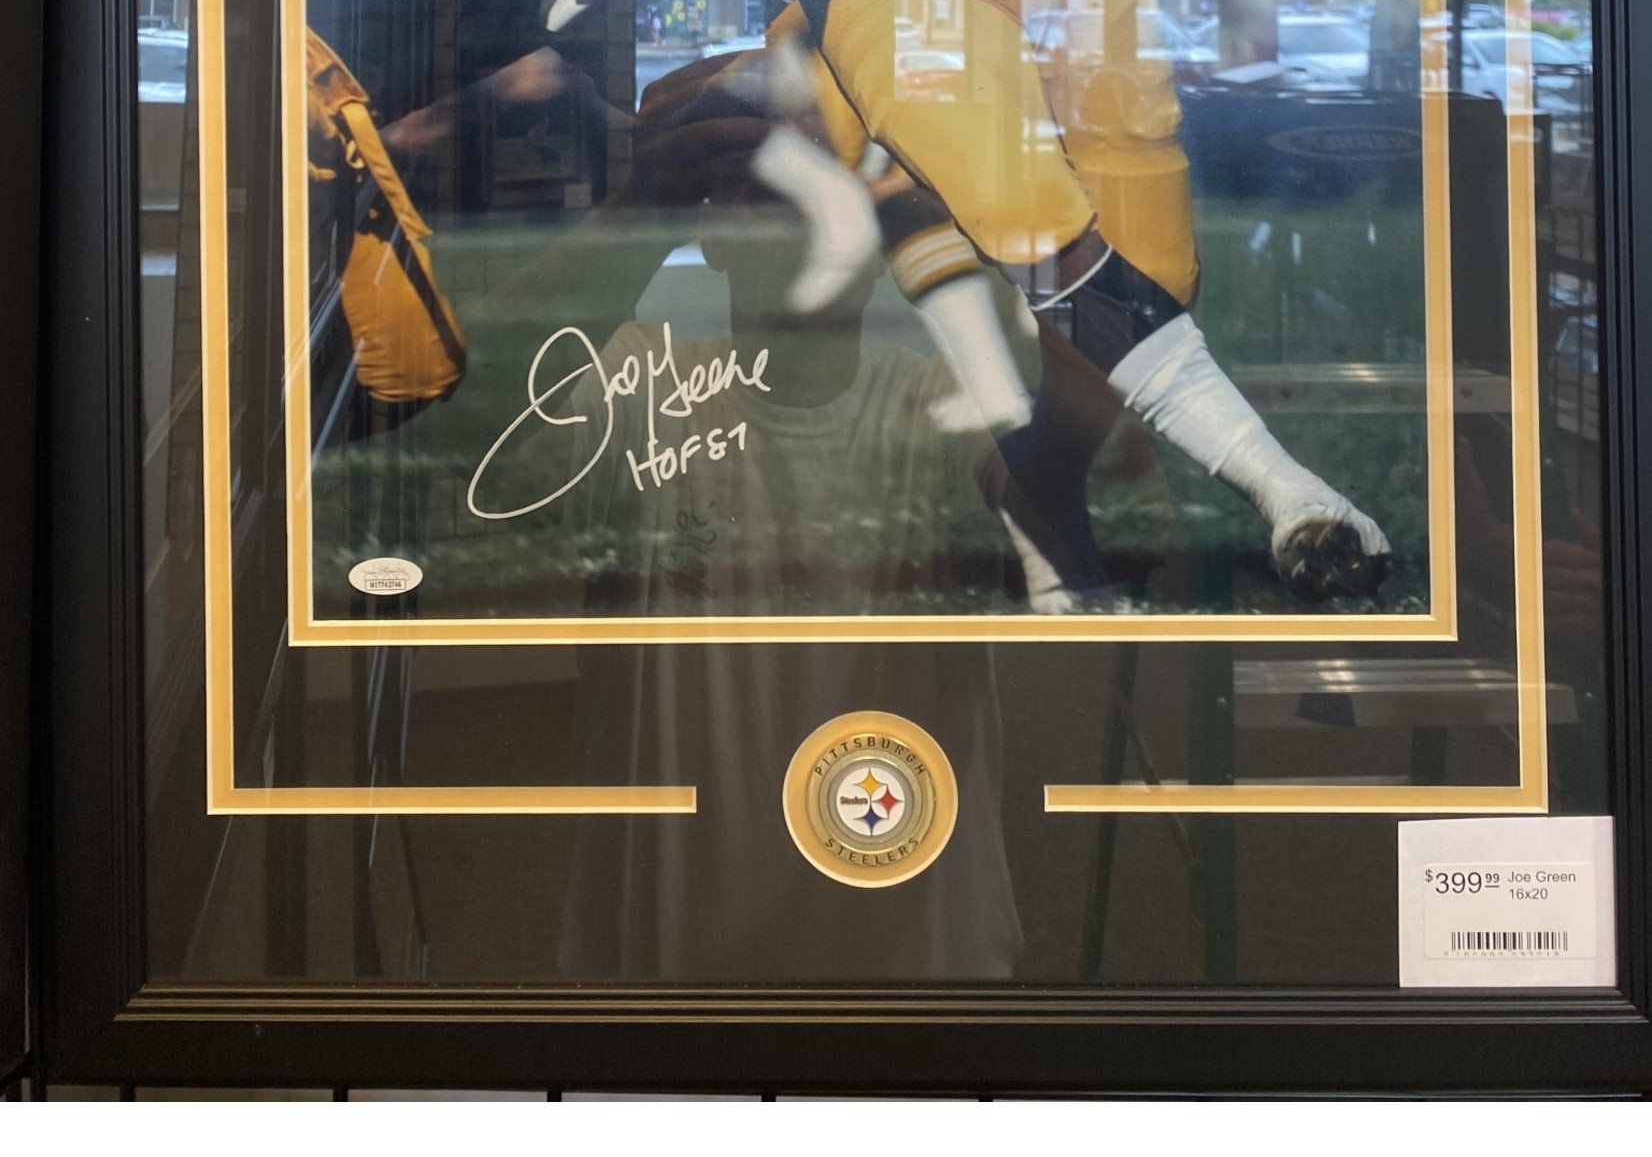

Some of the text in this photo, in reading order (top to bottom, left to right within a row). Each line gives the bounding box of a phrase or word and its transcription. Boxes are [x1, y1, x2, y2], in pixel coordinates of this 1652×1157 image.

[814, 736, 926, 776] PITTSBURGH
[840, 796, 868, 805] Steelers
[826, 837, 919, 865] STEELERS
[1507, 871, 1532, 883] Joe
[1535, 871, 1577, 883] Green
[1509, 888, 1549, 900] 16x20
